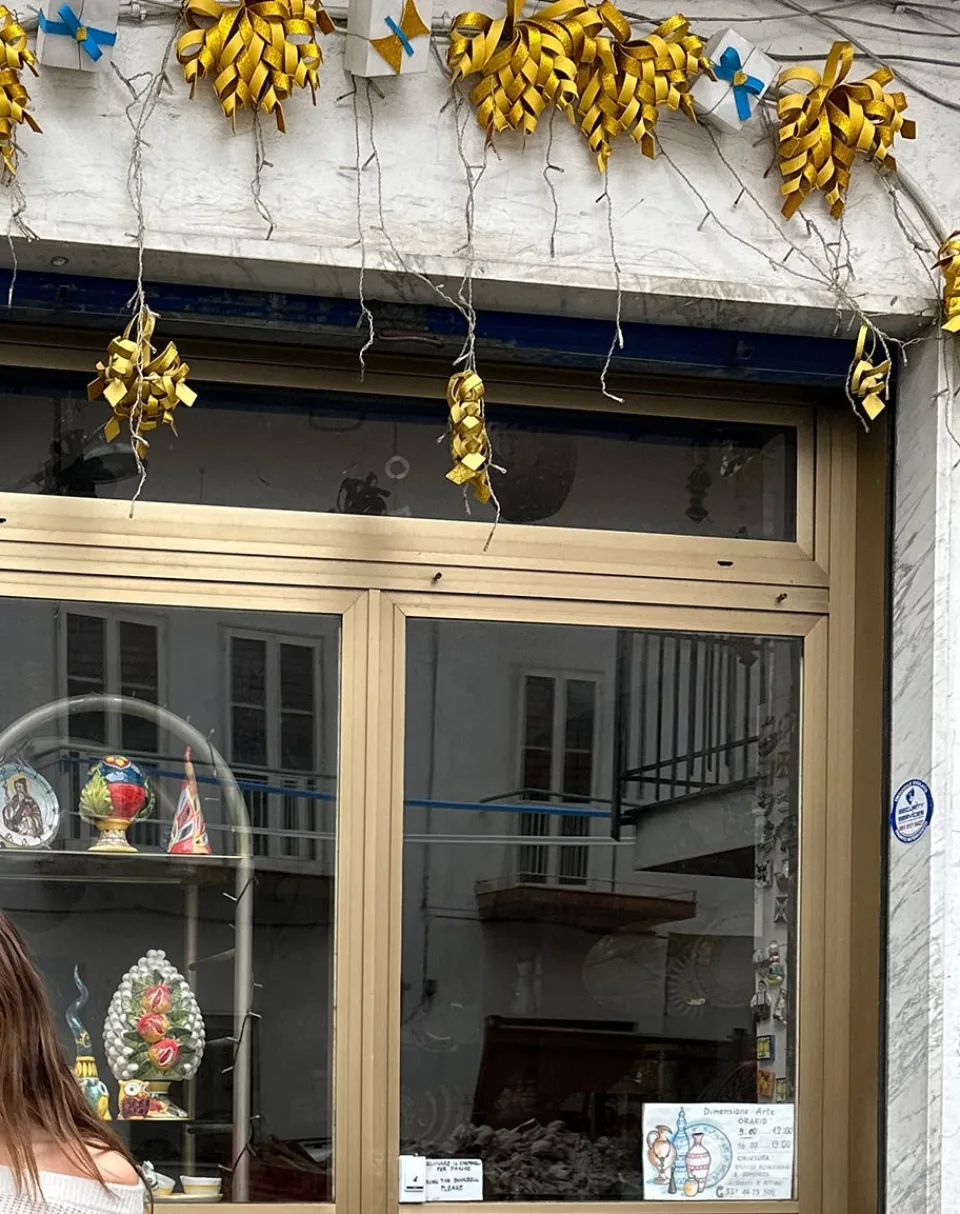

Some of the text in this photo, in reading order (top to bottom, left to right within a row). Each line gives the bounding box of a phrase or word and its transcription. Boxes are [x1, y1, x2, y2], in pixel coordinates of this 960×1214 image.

[704, 1107, 775, 1115] Dimensione Arte
[738, 1117, 767, 1125] ORARIO
